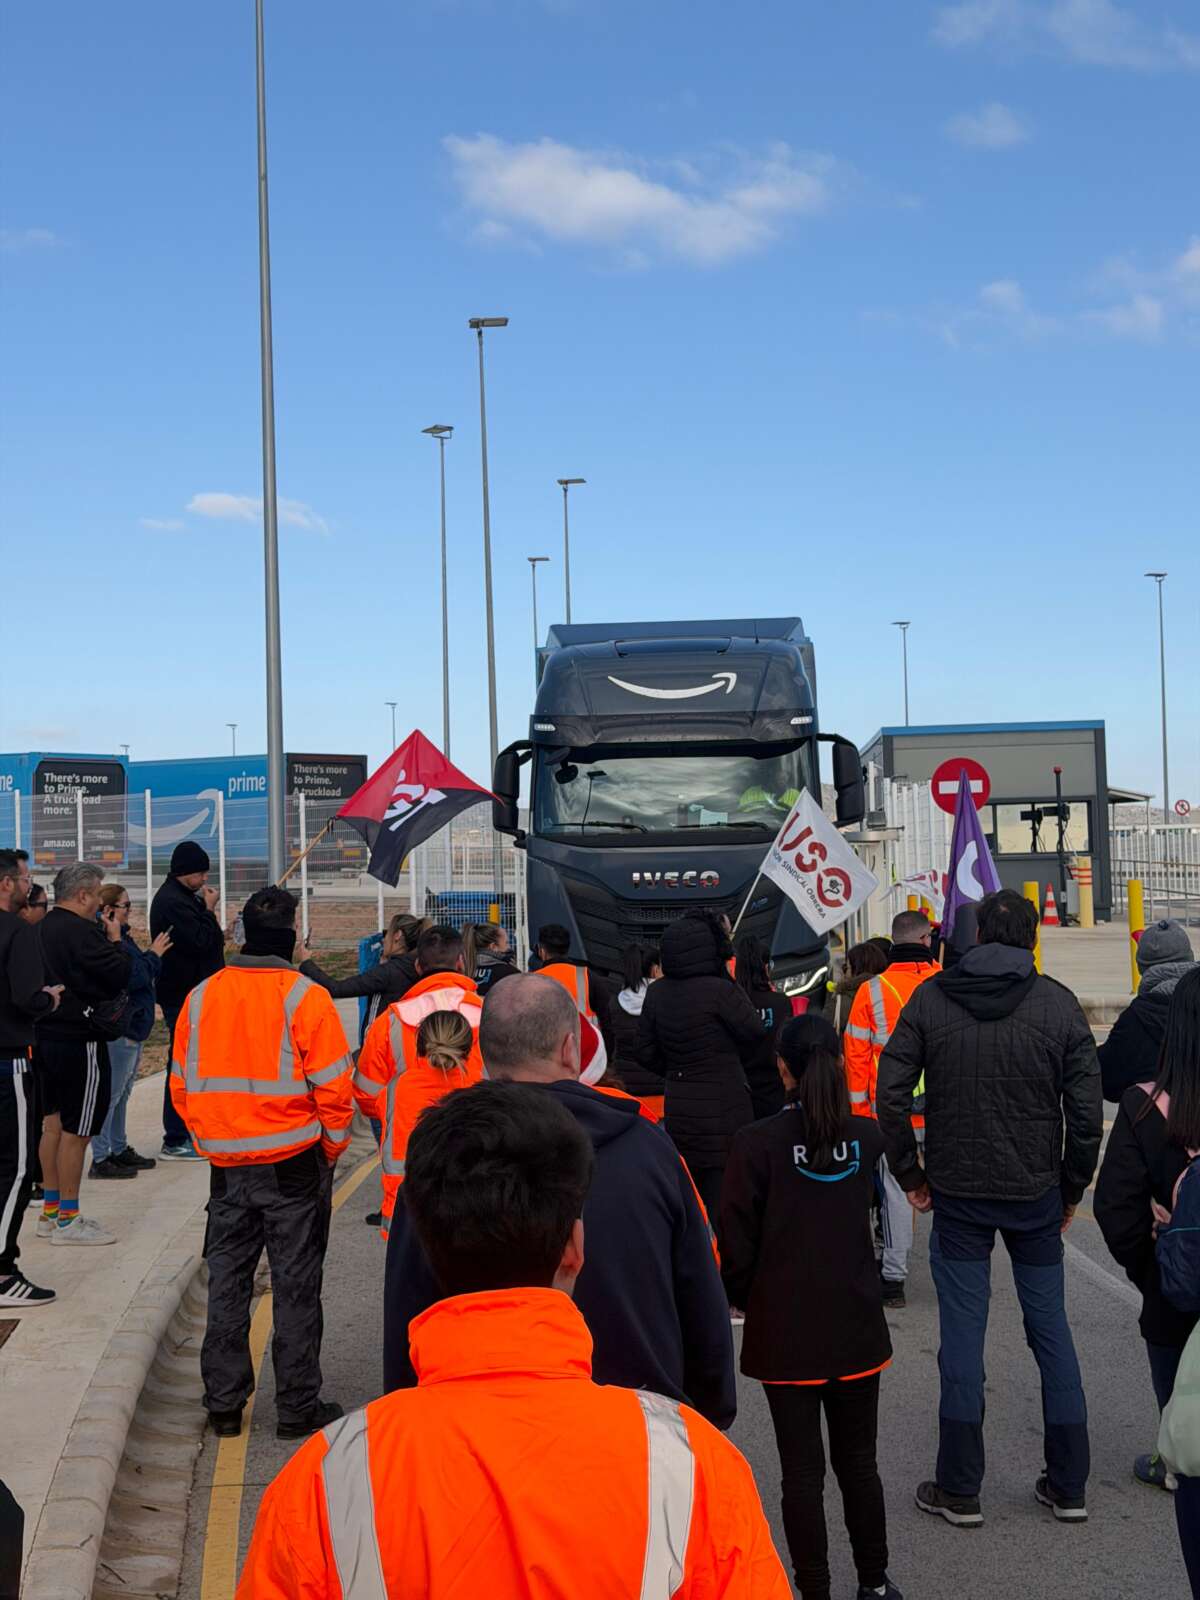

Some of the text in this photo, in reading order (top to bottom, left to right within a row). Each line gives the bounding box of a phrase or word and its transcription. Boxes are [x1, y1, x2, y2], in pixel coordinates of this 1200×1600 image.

[294, 764, 347, 774] There's more
[44, 773, 108, 783] There's more
[294, 775, 332, 784] to Prime.
[44, 784, 90, 793] to Prime.
[229, 771, 266, 798] prime
[44, 795, 101, 804] A truckoad
[43, 806, 72, 814] more.
[44, 840, 76, 848] amazon
[778, 811, 852, 908] USO
[632, 870, 720, 889] IVECO
[781, 860, 808, 888] SINDICAL
[806, 887, 827, 918] OBRERA
[793, 1140, 861, 1165] RU1
